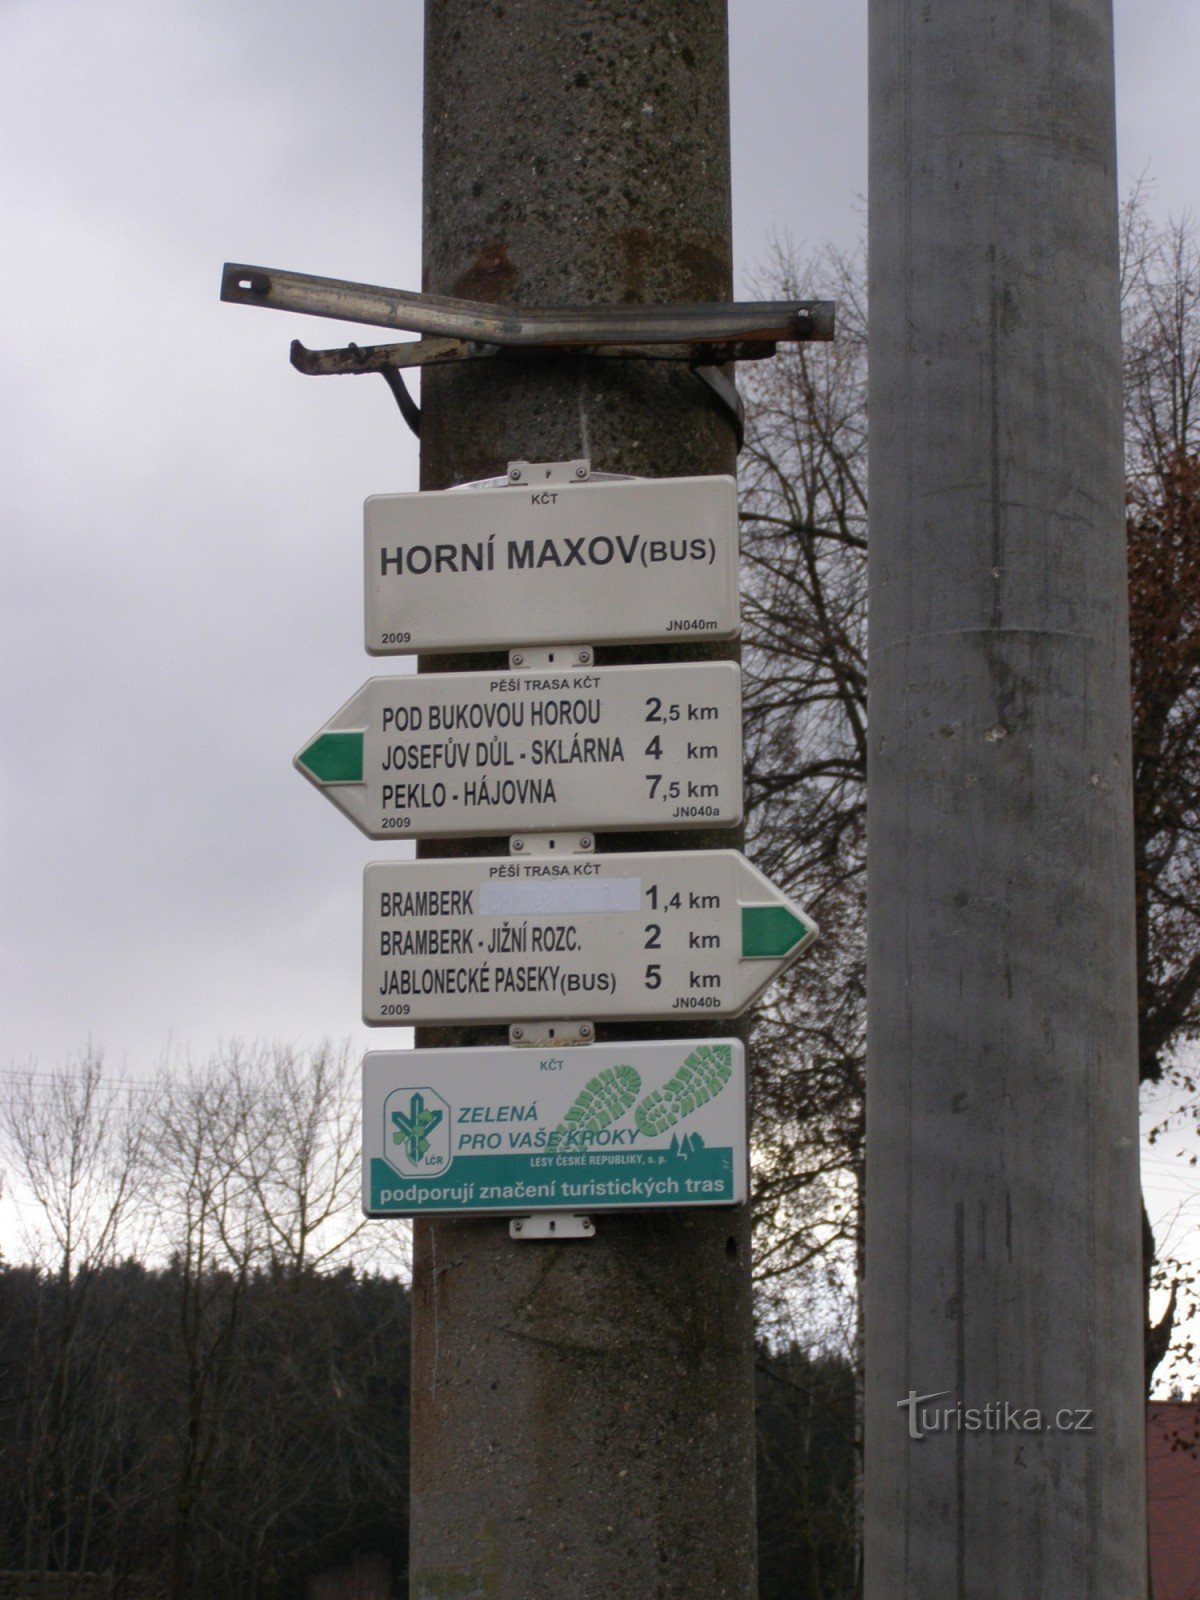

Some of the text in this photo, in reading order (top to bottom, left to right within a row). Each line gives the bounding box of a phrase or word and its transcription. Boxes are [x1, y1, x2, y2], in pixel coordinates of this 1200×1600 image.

[531, 494, 558, 505] KČT
[380, 534, 496, 575] HORNÍ
[666, 620, 718, 632] JN040m
[381, 633, 411, 644] 2009
[490, 677, 600, 692] PĚŠÍ TRASA KČT
[383, 698, 719, 731] POD BUKOVOU HOROU 2,5 km
[382, 736, 470, 770] JOSEFŮV
[476, 735, 514, 767] DŮL
[531, 732, 625, 764] SKLÁRNA
[645, 736, 663, 760] 4
[687, 742, 718, 759] km
[383, 783, 446, 809] PEKLO
[464, 775, 556, 806] HÁJOVNA
[645, 775, 681, 802] 7,5
[688, 781, 719, 797] km
[672, 805, 720, 818] JN040a
[381, 817, 411, 828] 2009
[489, 863, 601, 878] PĚŠÍ TRASA KČT
[380, 885, 720, 917] BRAMBERK 1,4 km
[380, 929, 474, 956] BRAMBERK
[487, 921, 527, 954] JIŽNÍ
[532, 927, 581, 951] ROZC.
[644, 925, 662, 949] 2
[689, 932, 720, 948] km
[380, 962, 490, 995] JABLONECKÉ
[644, 964, 662, 989] 5
[689, 972, 721, 988] km
[381, 1004, 410, 1015] 2009
[672, 997, 721, 1009] JN040b
[540, 1059, 564, 1071] KČT
[458, 1101, 538, 1124] ZELENÁ
[458, 1127, 640, 1149] PRO VAŠE KROKY
[531, 1158, 554, 1167] LESY
[556, 1155, 586, 1166] ČESKÉ
[589, 1155, 645, 1165] REPUBLIKY,
[380, 1176, 725, 1205] podporují značení turistických tras
